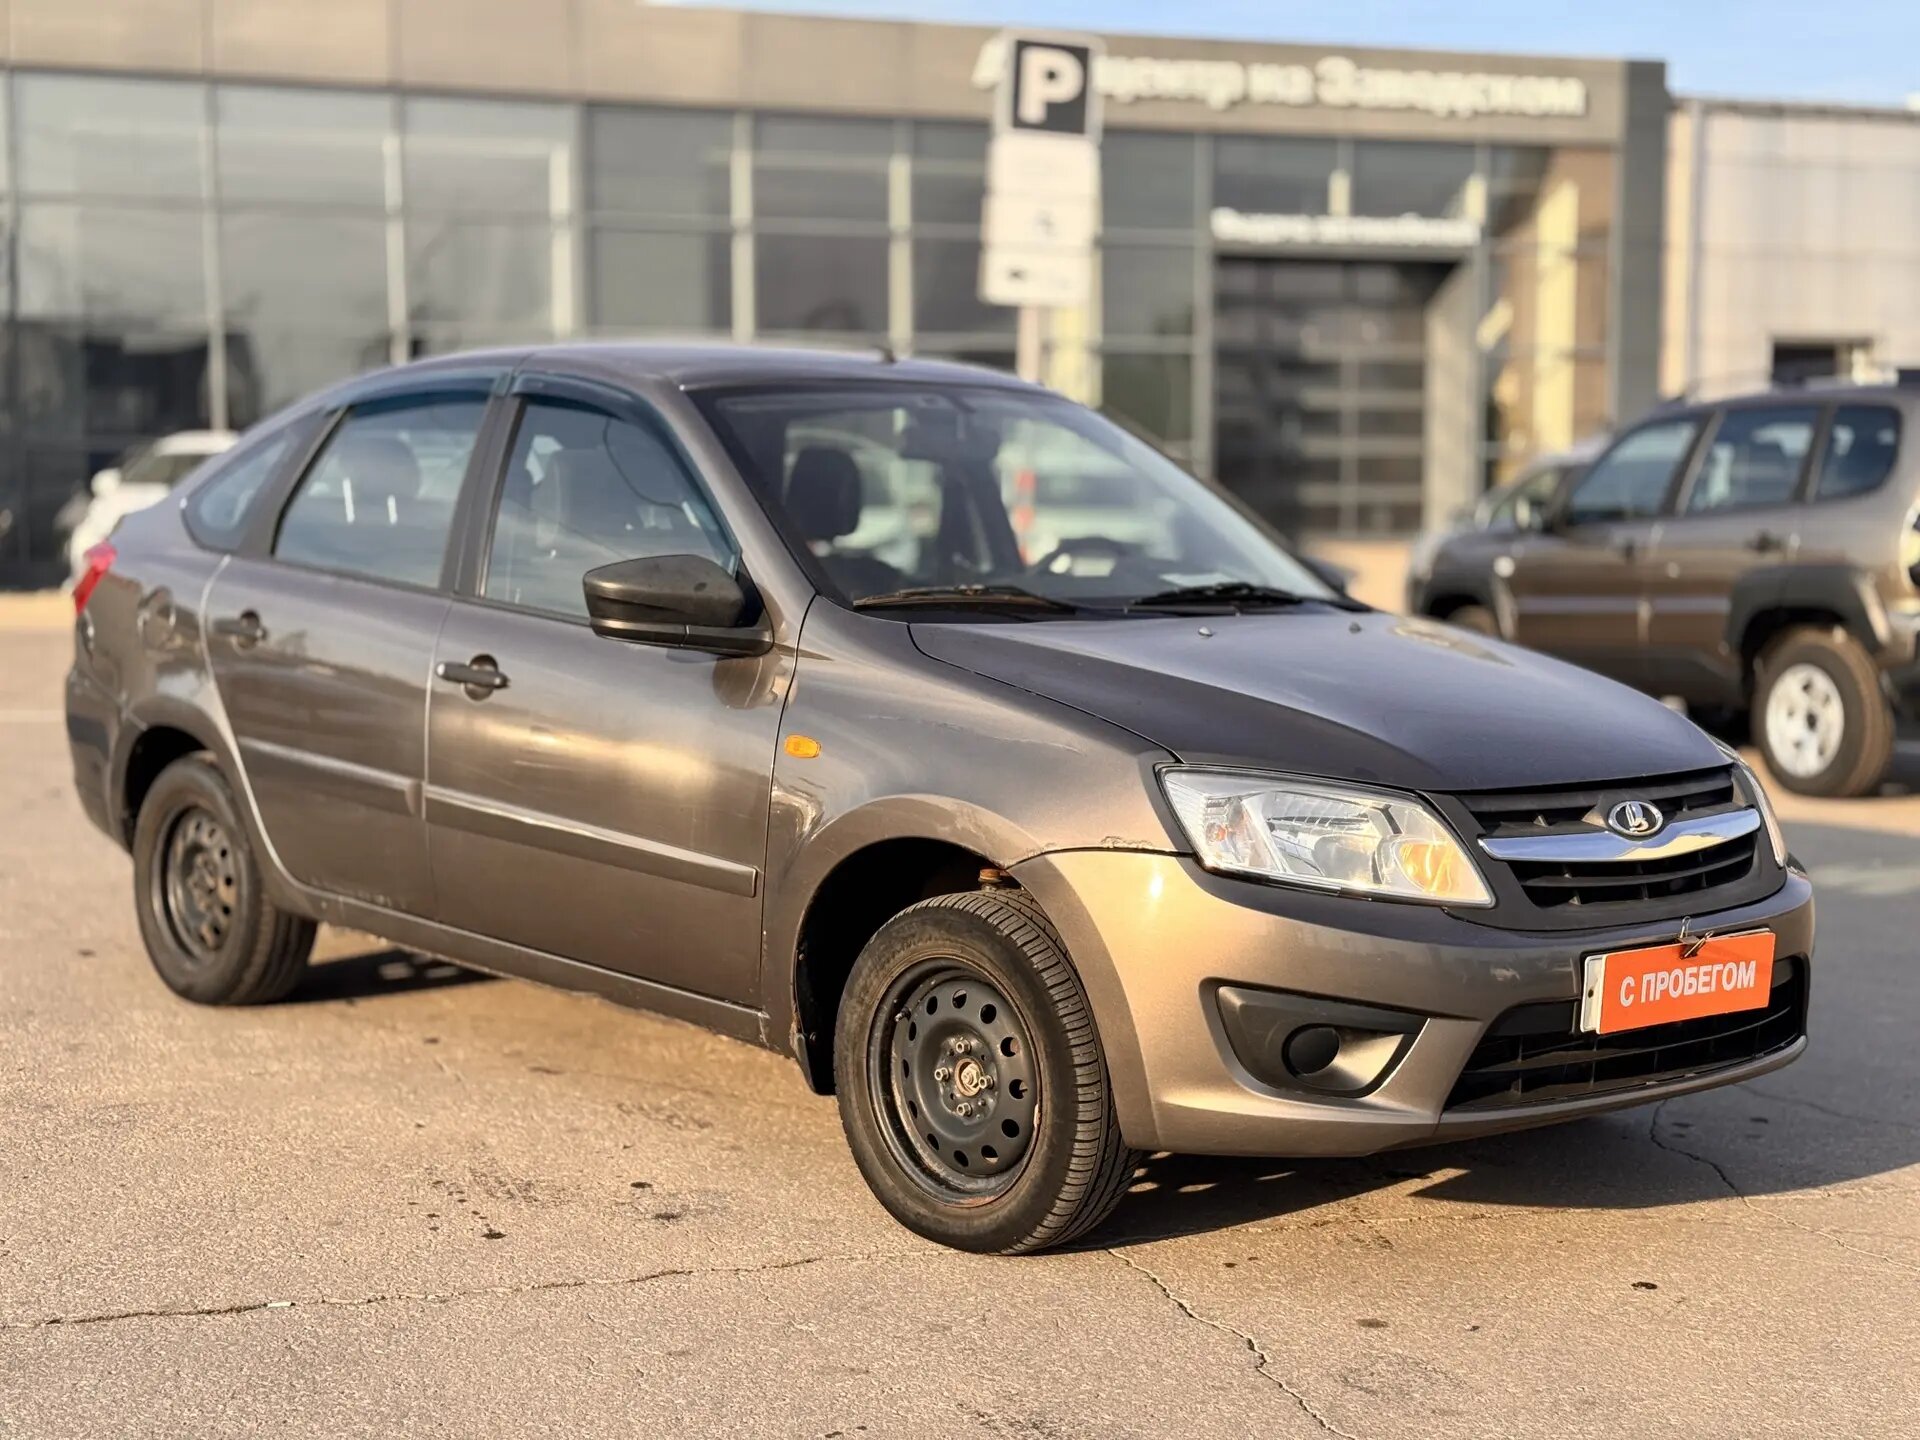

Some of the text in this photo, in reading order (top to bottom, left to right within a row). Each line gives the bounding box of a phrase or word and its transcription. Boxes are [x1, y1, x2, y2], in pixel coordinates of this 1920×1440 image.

[1017, 46, 1084, 124] P
[1620, 960, 1757, 1008] С ПРОБЕГОМ
